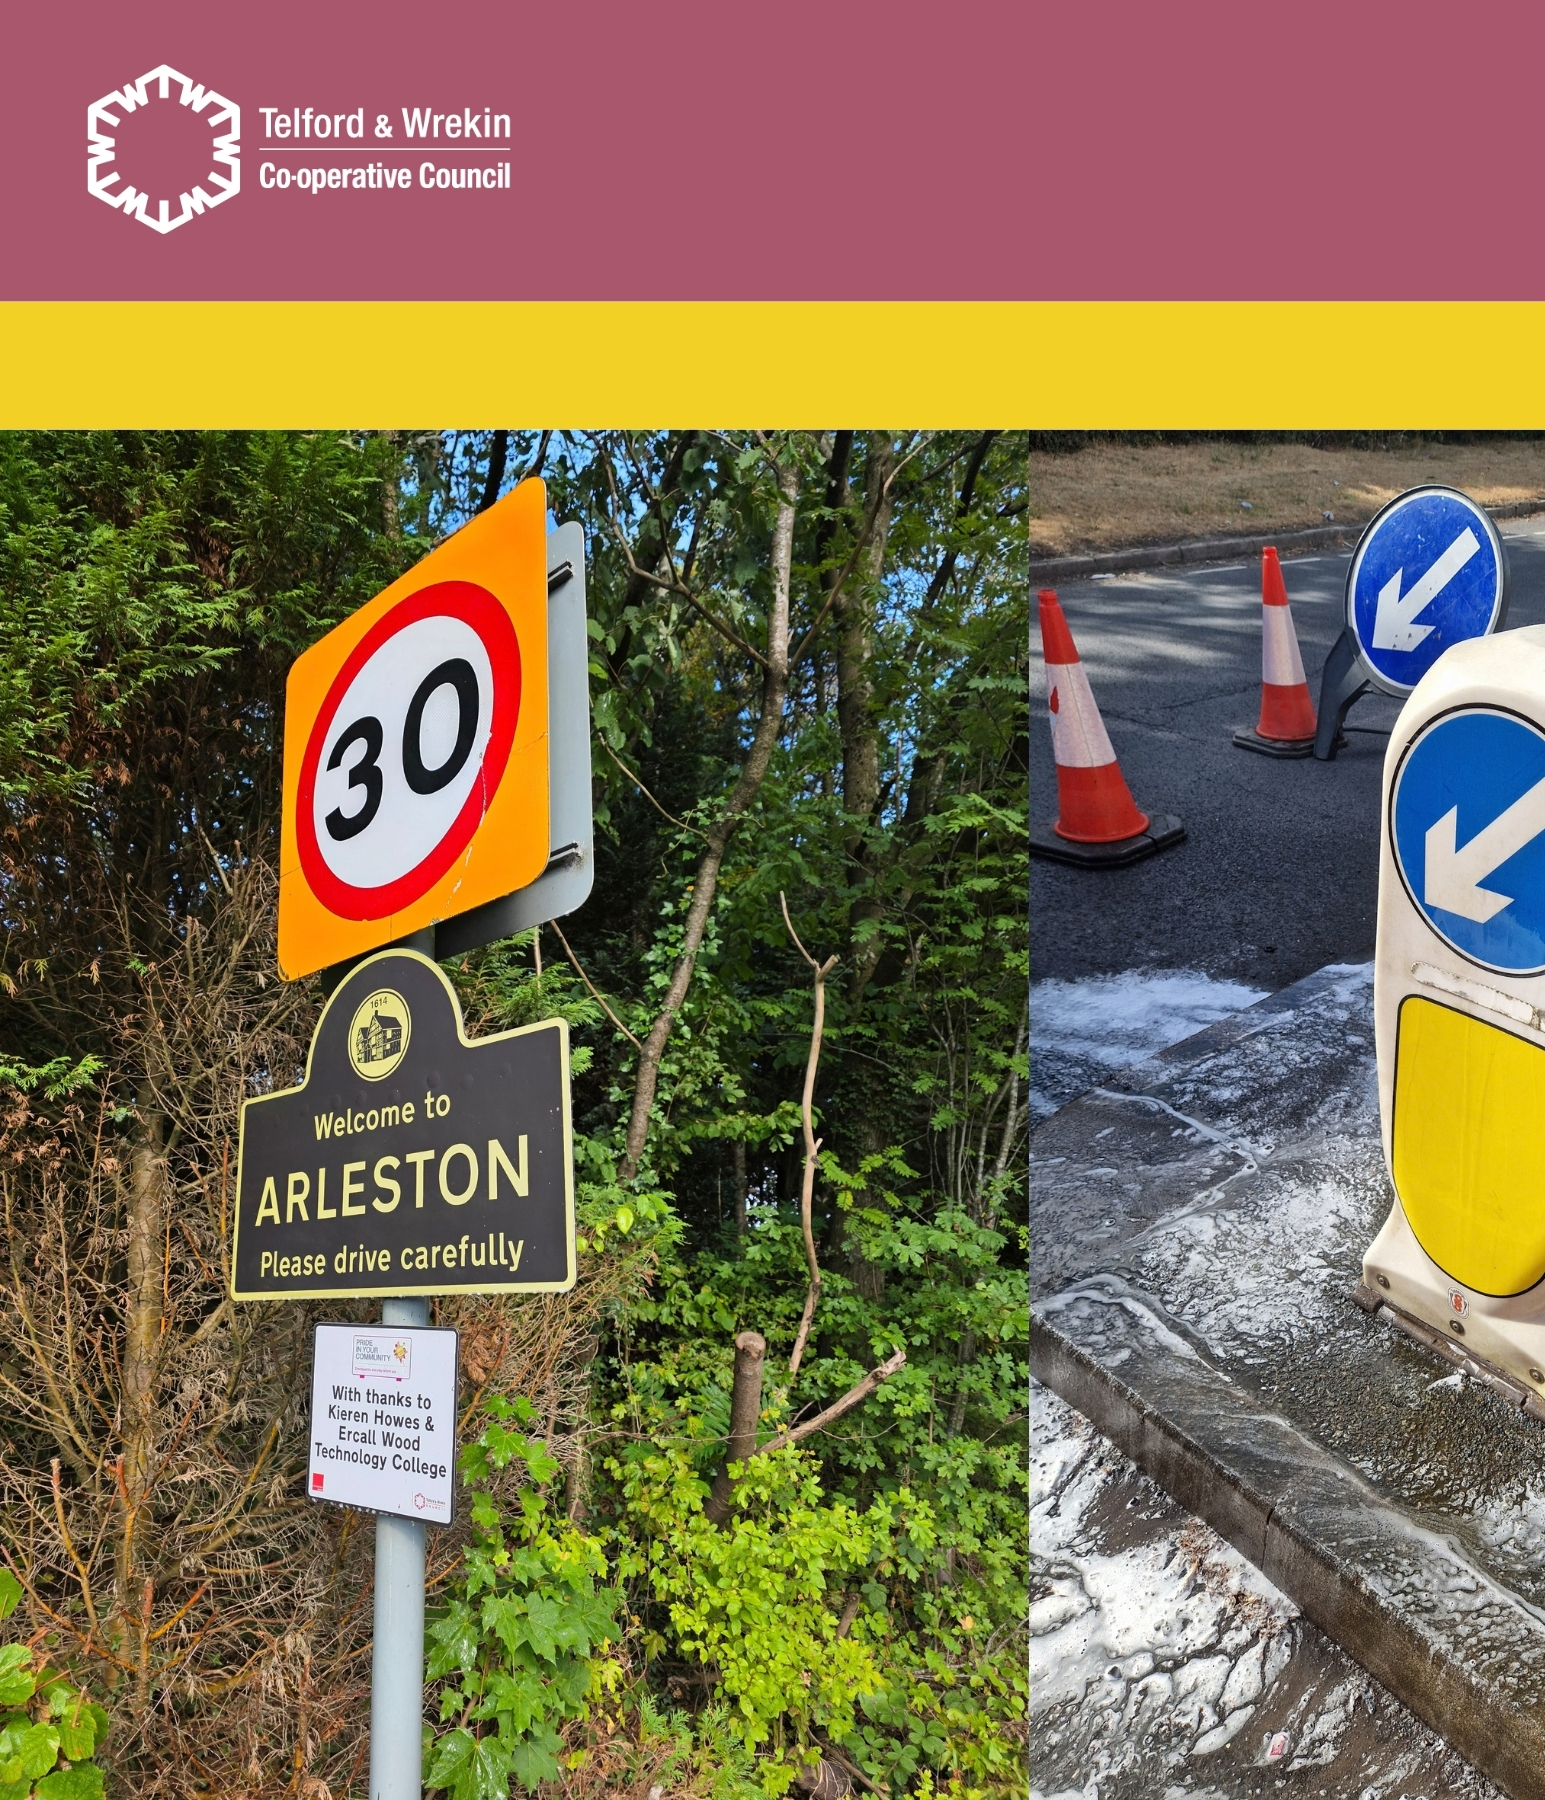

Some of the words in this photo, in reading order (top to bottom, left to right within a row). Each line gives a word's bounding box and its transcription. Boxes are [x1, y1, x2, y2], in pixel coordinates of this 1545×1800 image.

[325, 658, 479, 841] 30
[370, 996, 388, 1009] 1614
[314, 1101, 414, 1140] Welcome
[425, 1091, 450, 1119] to
[255, 1134, 529, 1227] ARLESTON
[260, 1250, 326, 1277] Please
[334, 1244, 391, 1273] drive
[400, 1232, 524, 1271] carefully
[355, 1353, 391, 1362] COMMUNITY
[363, 1346, 378, 1354] YOUR
[332, 1385, 361, 1402] With
[366, 1388, 412, 1407] thanks
[417, 1393, 431, 1410] to
[328, 1404, 368, 1423] Kieren
[374, 1410, 419, 1430] Howes
[425, 1416, 435, 1432] &
[339, 1425, 376, 1445] Ercall
[382, 1431, 420, 1451] Wood
[315, 1442, 387, 1470] Technology
[392, 1454, 447, 1479] College
